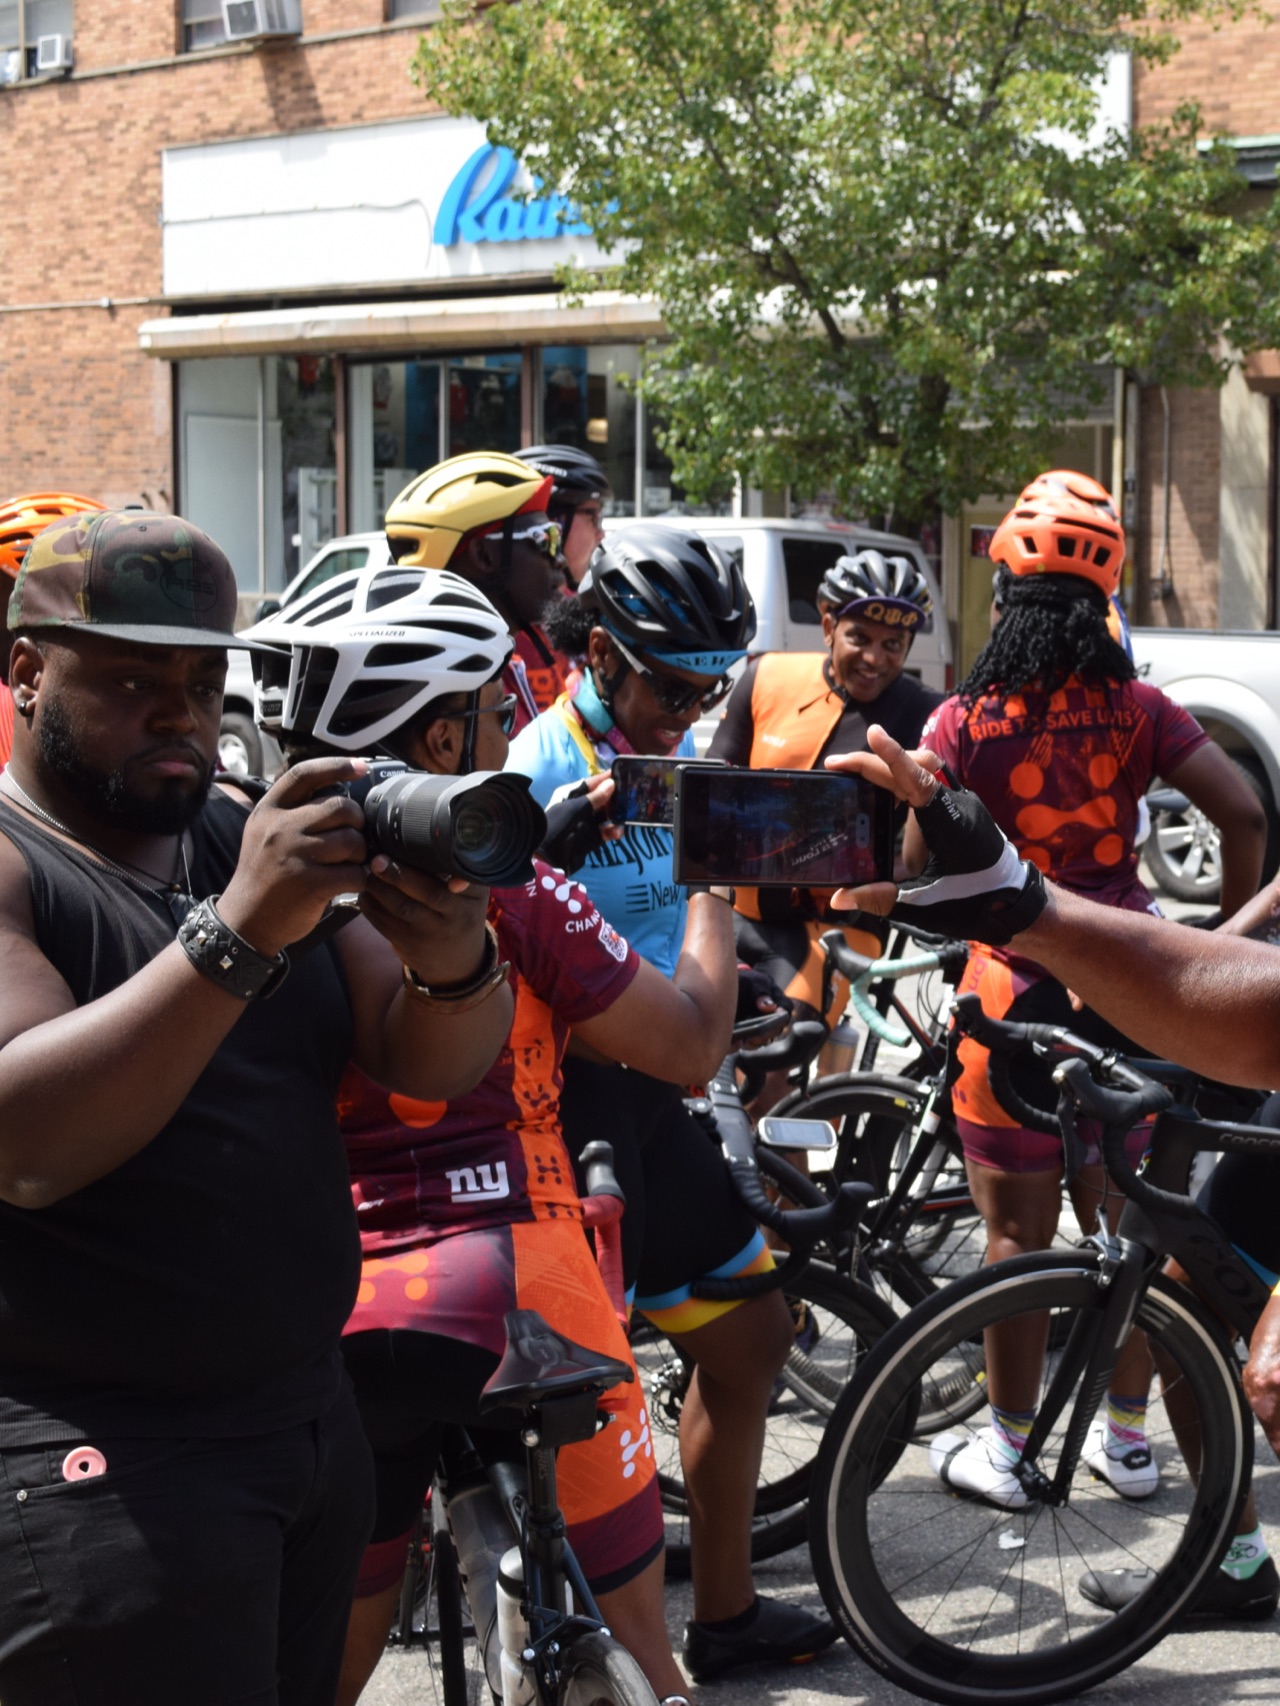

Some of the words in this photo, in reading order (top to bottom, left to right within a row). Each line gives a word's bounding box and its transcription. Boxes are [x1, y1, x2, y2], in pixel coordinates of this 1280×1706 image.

[968, 719, 1012, 742] RIDE
[1046, 710, 1092, 730] SAVE
[651, 882, 680, 911] New
[565, 909, 600, 933] CHAN
